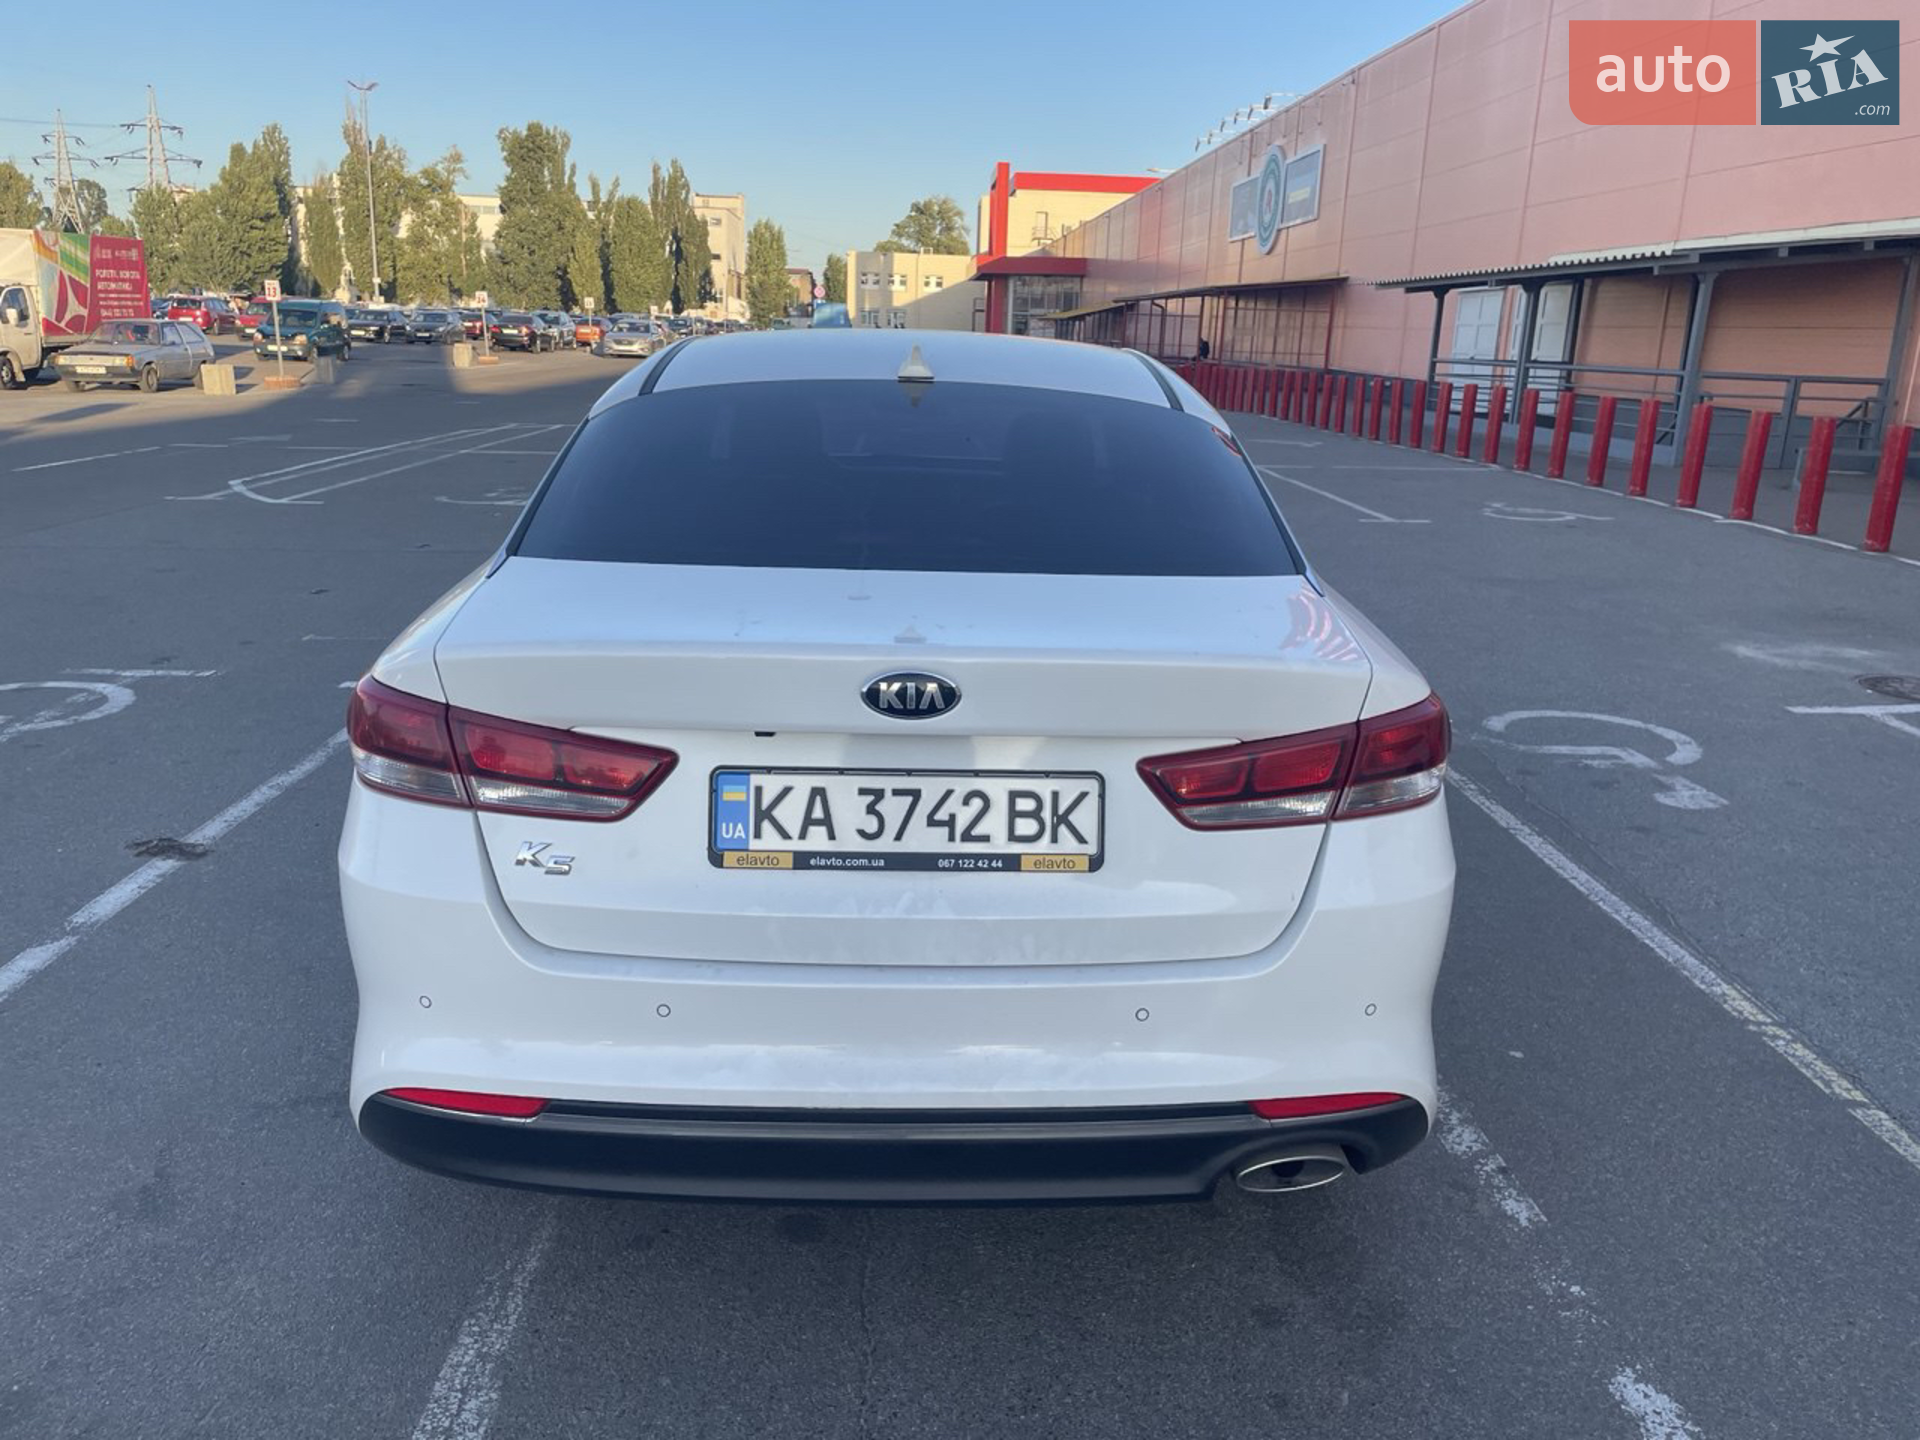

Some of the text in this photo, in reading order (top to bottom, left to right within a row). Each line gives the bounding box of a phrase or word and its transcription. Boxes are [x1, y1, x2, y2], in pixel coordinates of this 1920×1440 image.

[878, 682, 946, 709] KIA
[752, 785, 1090, 845] KA 3742 BK
[722, 823, 746, 840] UA
[736, 853, 780, 867] elavto
[809, 856, 885, 867] elavto.com.ua
[937, 858, 1003, 868] 067 122 42 44
[1033, 857, 1076, 870] elavto
